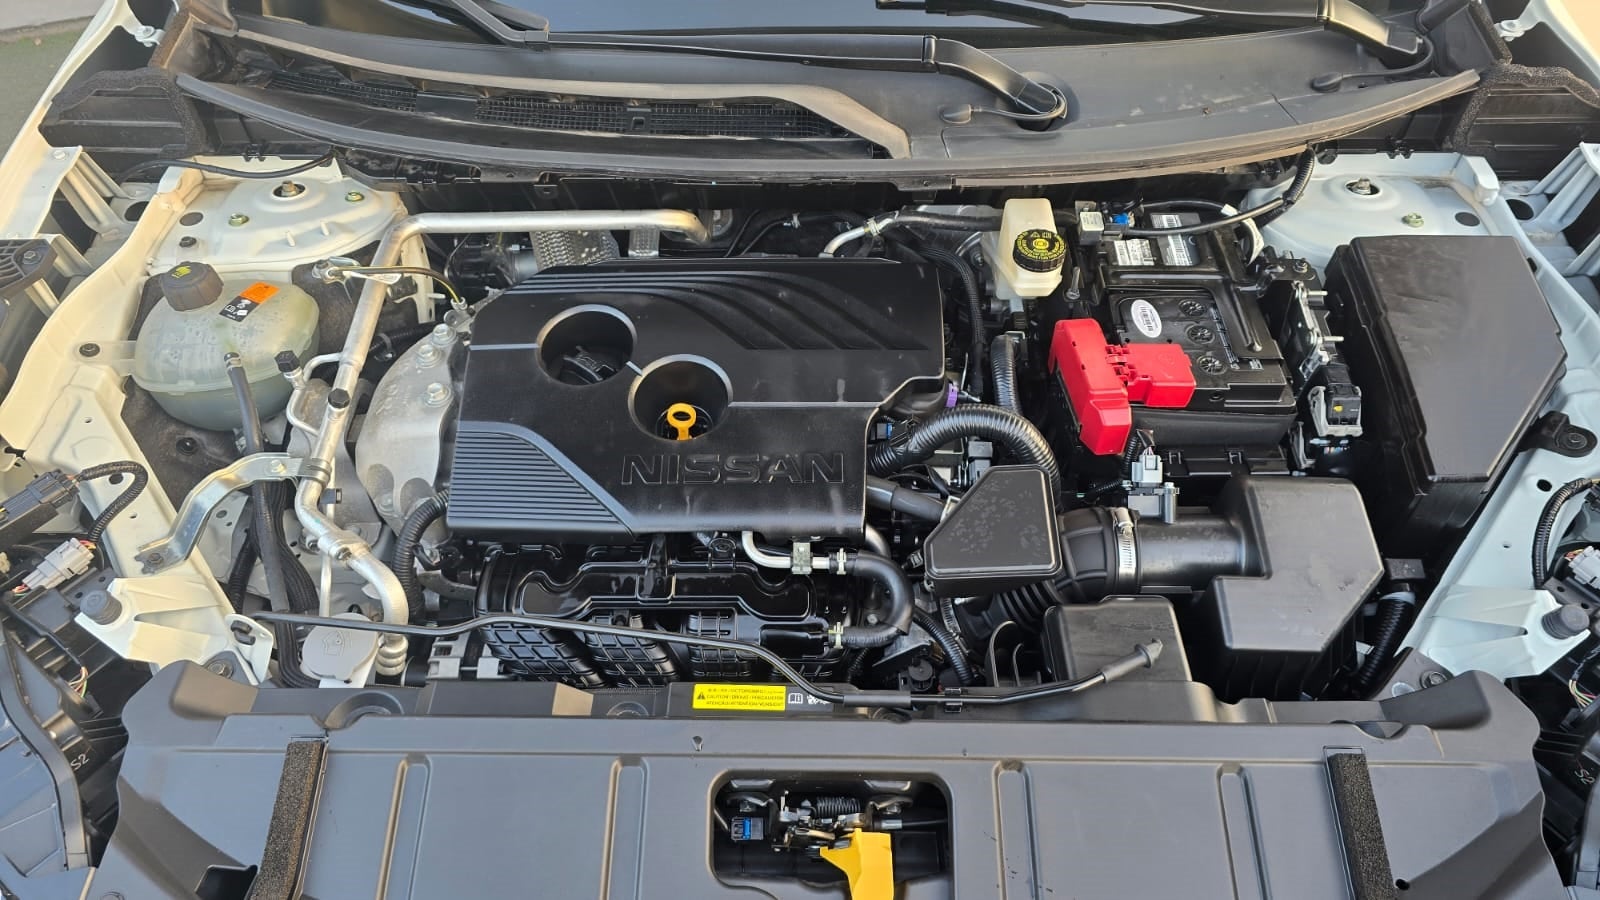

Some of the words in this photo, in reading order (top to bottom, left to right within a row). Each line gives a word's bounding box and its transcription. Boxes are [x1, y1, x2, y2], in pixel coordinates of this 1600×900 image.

[621, 453, 844, 485] NISSAN
[70, 753, 90, 770] S2
[1574, 769, 1595, 784] S2
